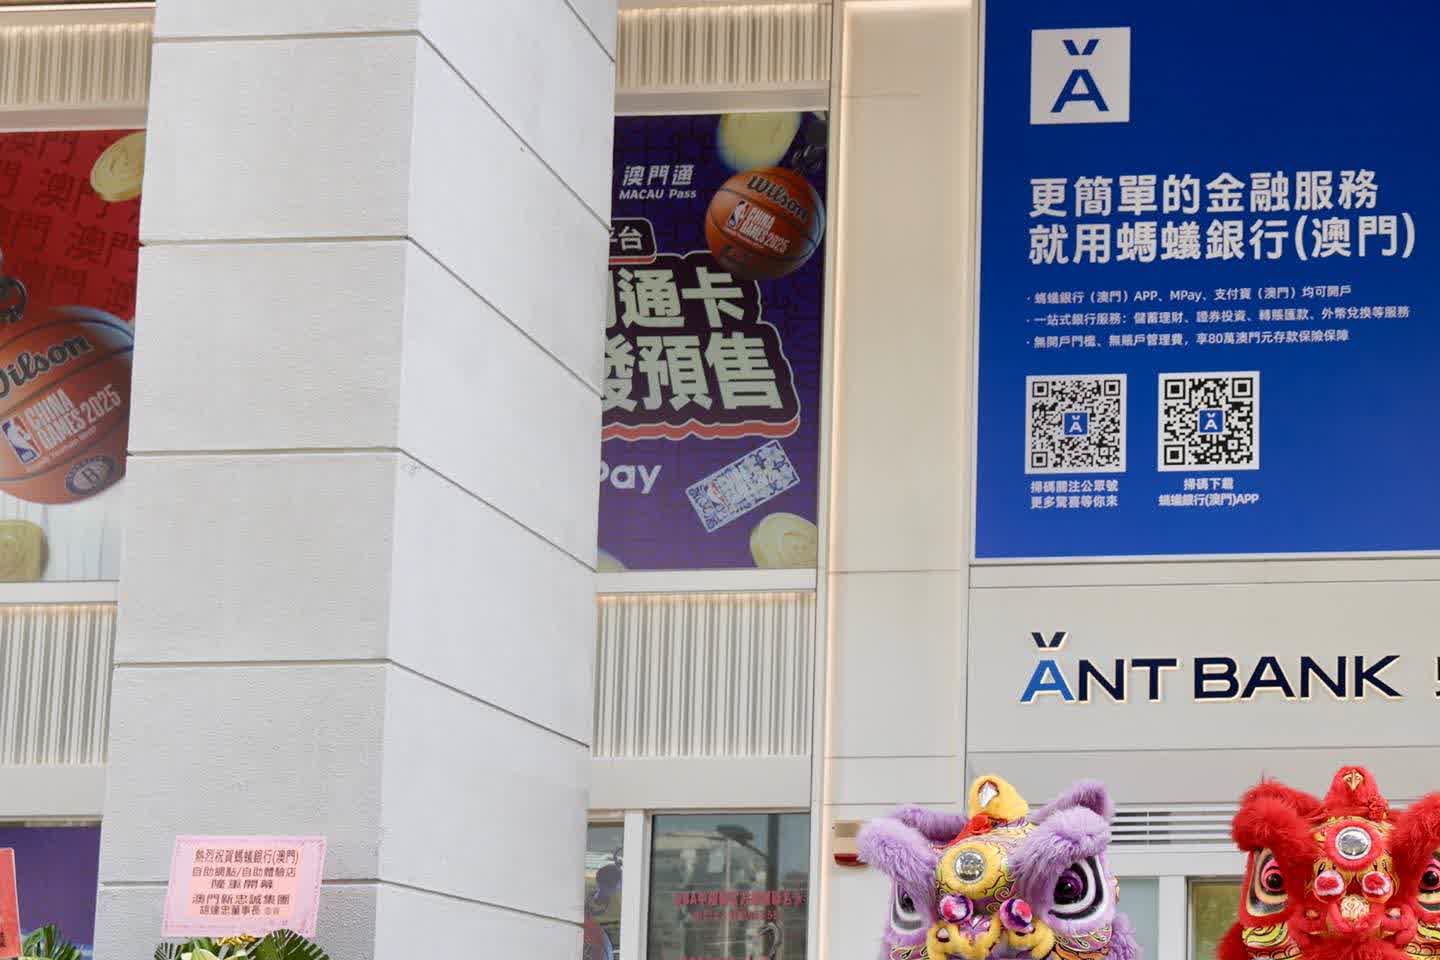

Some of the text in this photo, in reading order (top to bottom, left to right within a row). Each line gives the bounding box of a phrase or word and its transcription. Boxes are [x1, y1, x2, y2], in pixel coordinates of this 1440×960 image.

[619, 188, 697, 200] MACAU Pass
[622, 164, 695, 187] 澳門通
[1029, 170, 1378, 217] 更簡單的金融服務
[1028, 213, 1415, 264] 就用螞蟻銀行(澳門)
[606, 267, 744, 328] 通卡
[24, 388, 76, 427] CHINA
[80, 384, 121, 424] 2025
[1193, 655, 1402, 700] BANK
